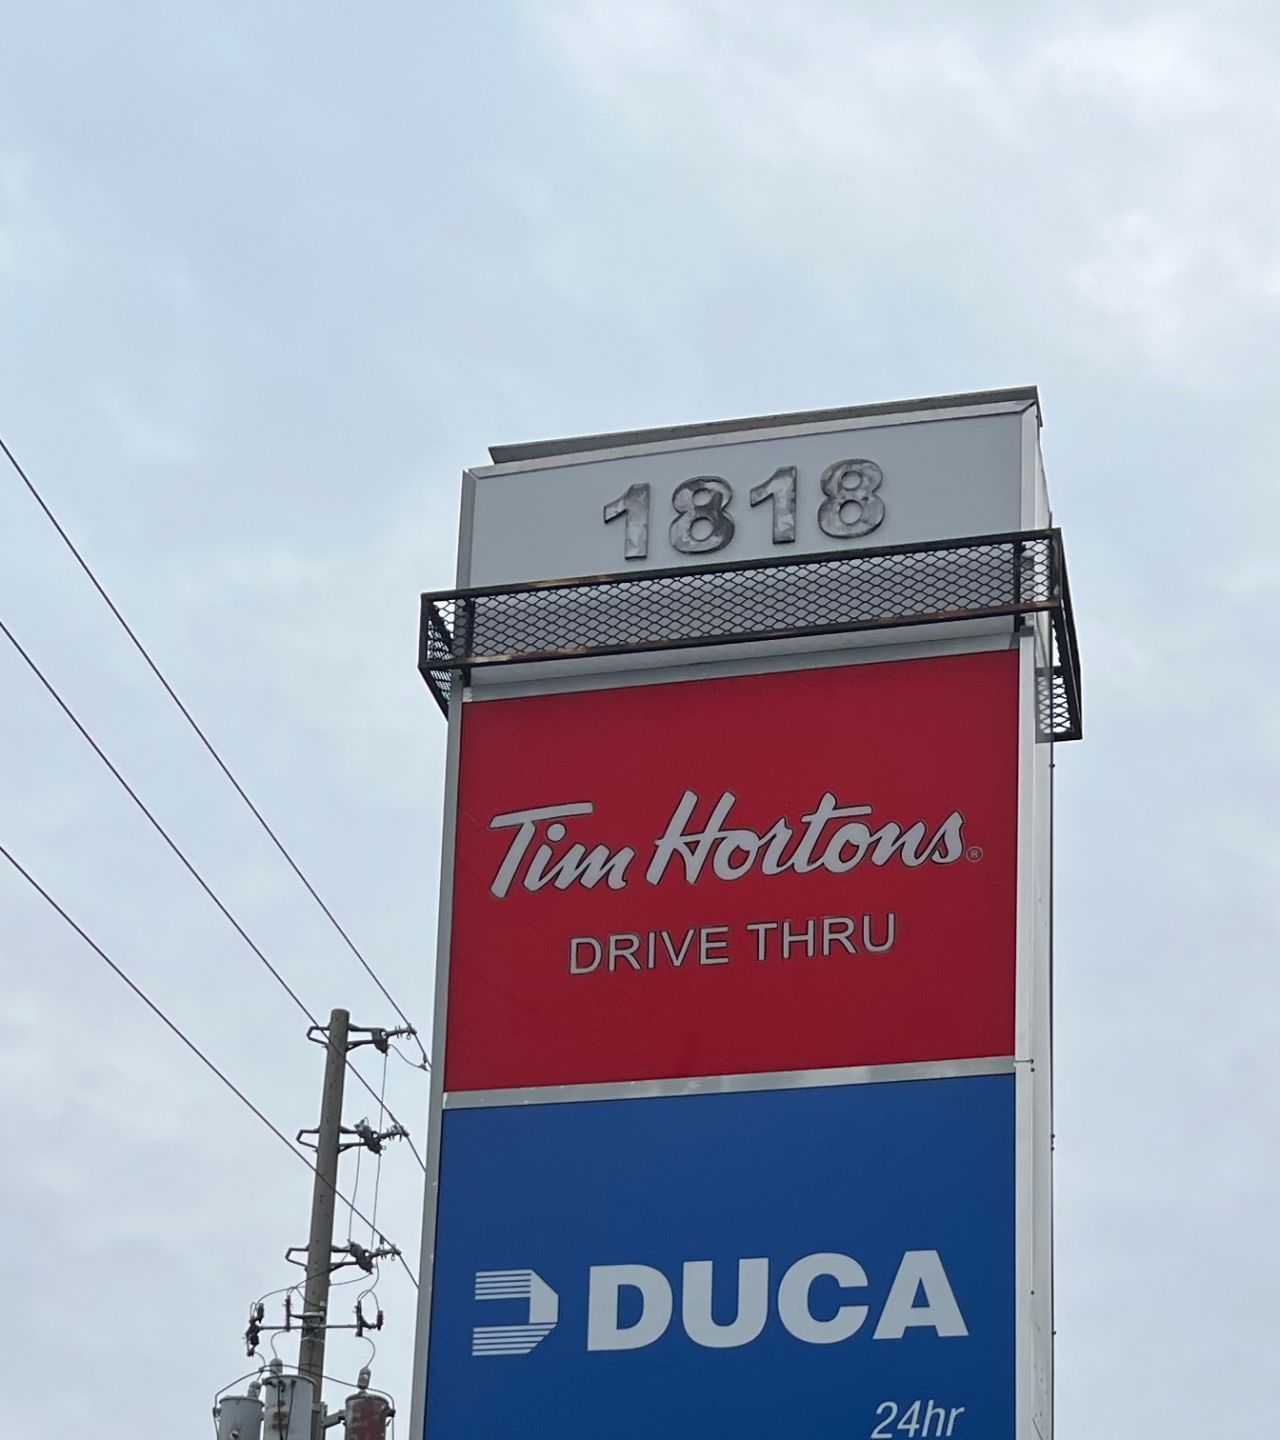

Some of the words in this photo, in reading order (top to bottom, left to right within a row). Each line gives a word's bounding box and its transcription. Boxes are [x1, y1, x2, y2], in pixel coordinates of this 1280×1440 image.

[603, 459, 886, 560] 1818
[489, 801, 636, 898] Tim
[646, 790, 964, 886] Hortons
[569, 926, 730, 974] DRIVE
[747, 913, 896, 961] THRU
[587, 1250, 969, 1351] DUCA
[871, 1400, 965, 1439] 24hr
